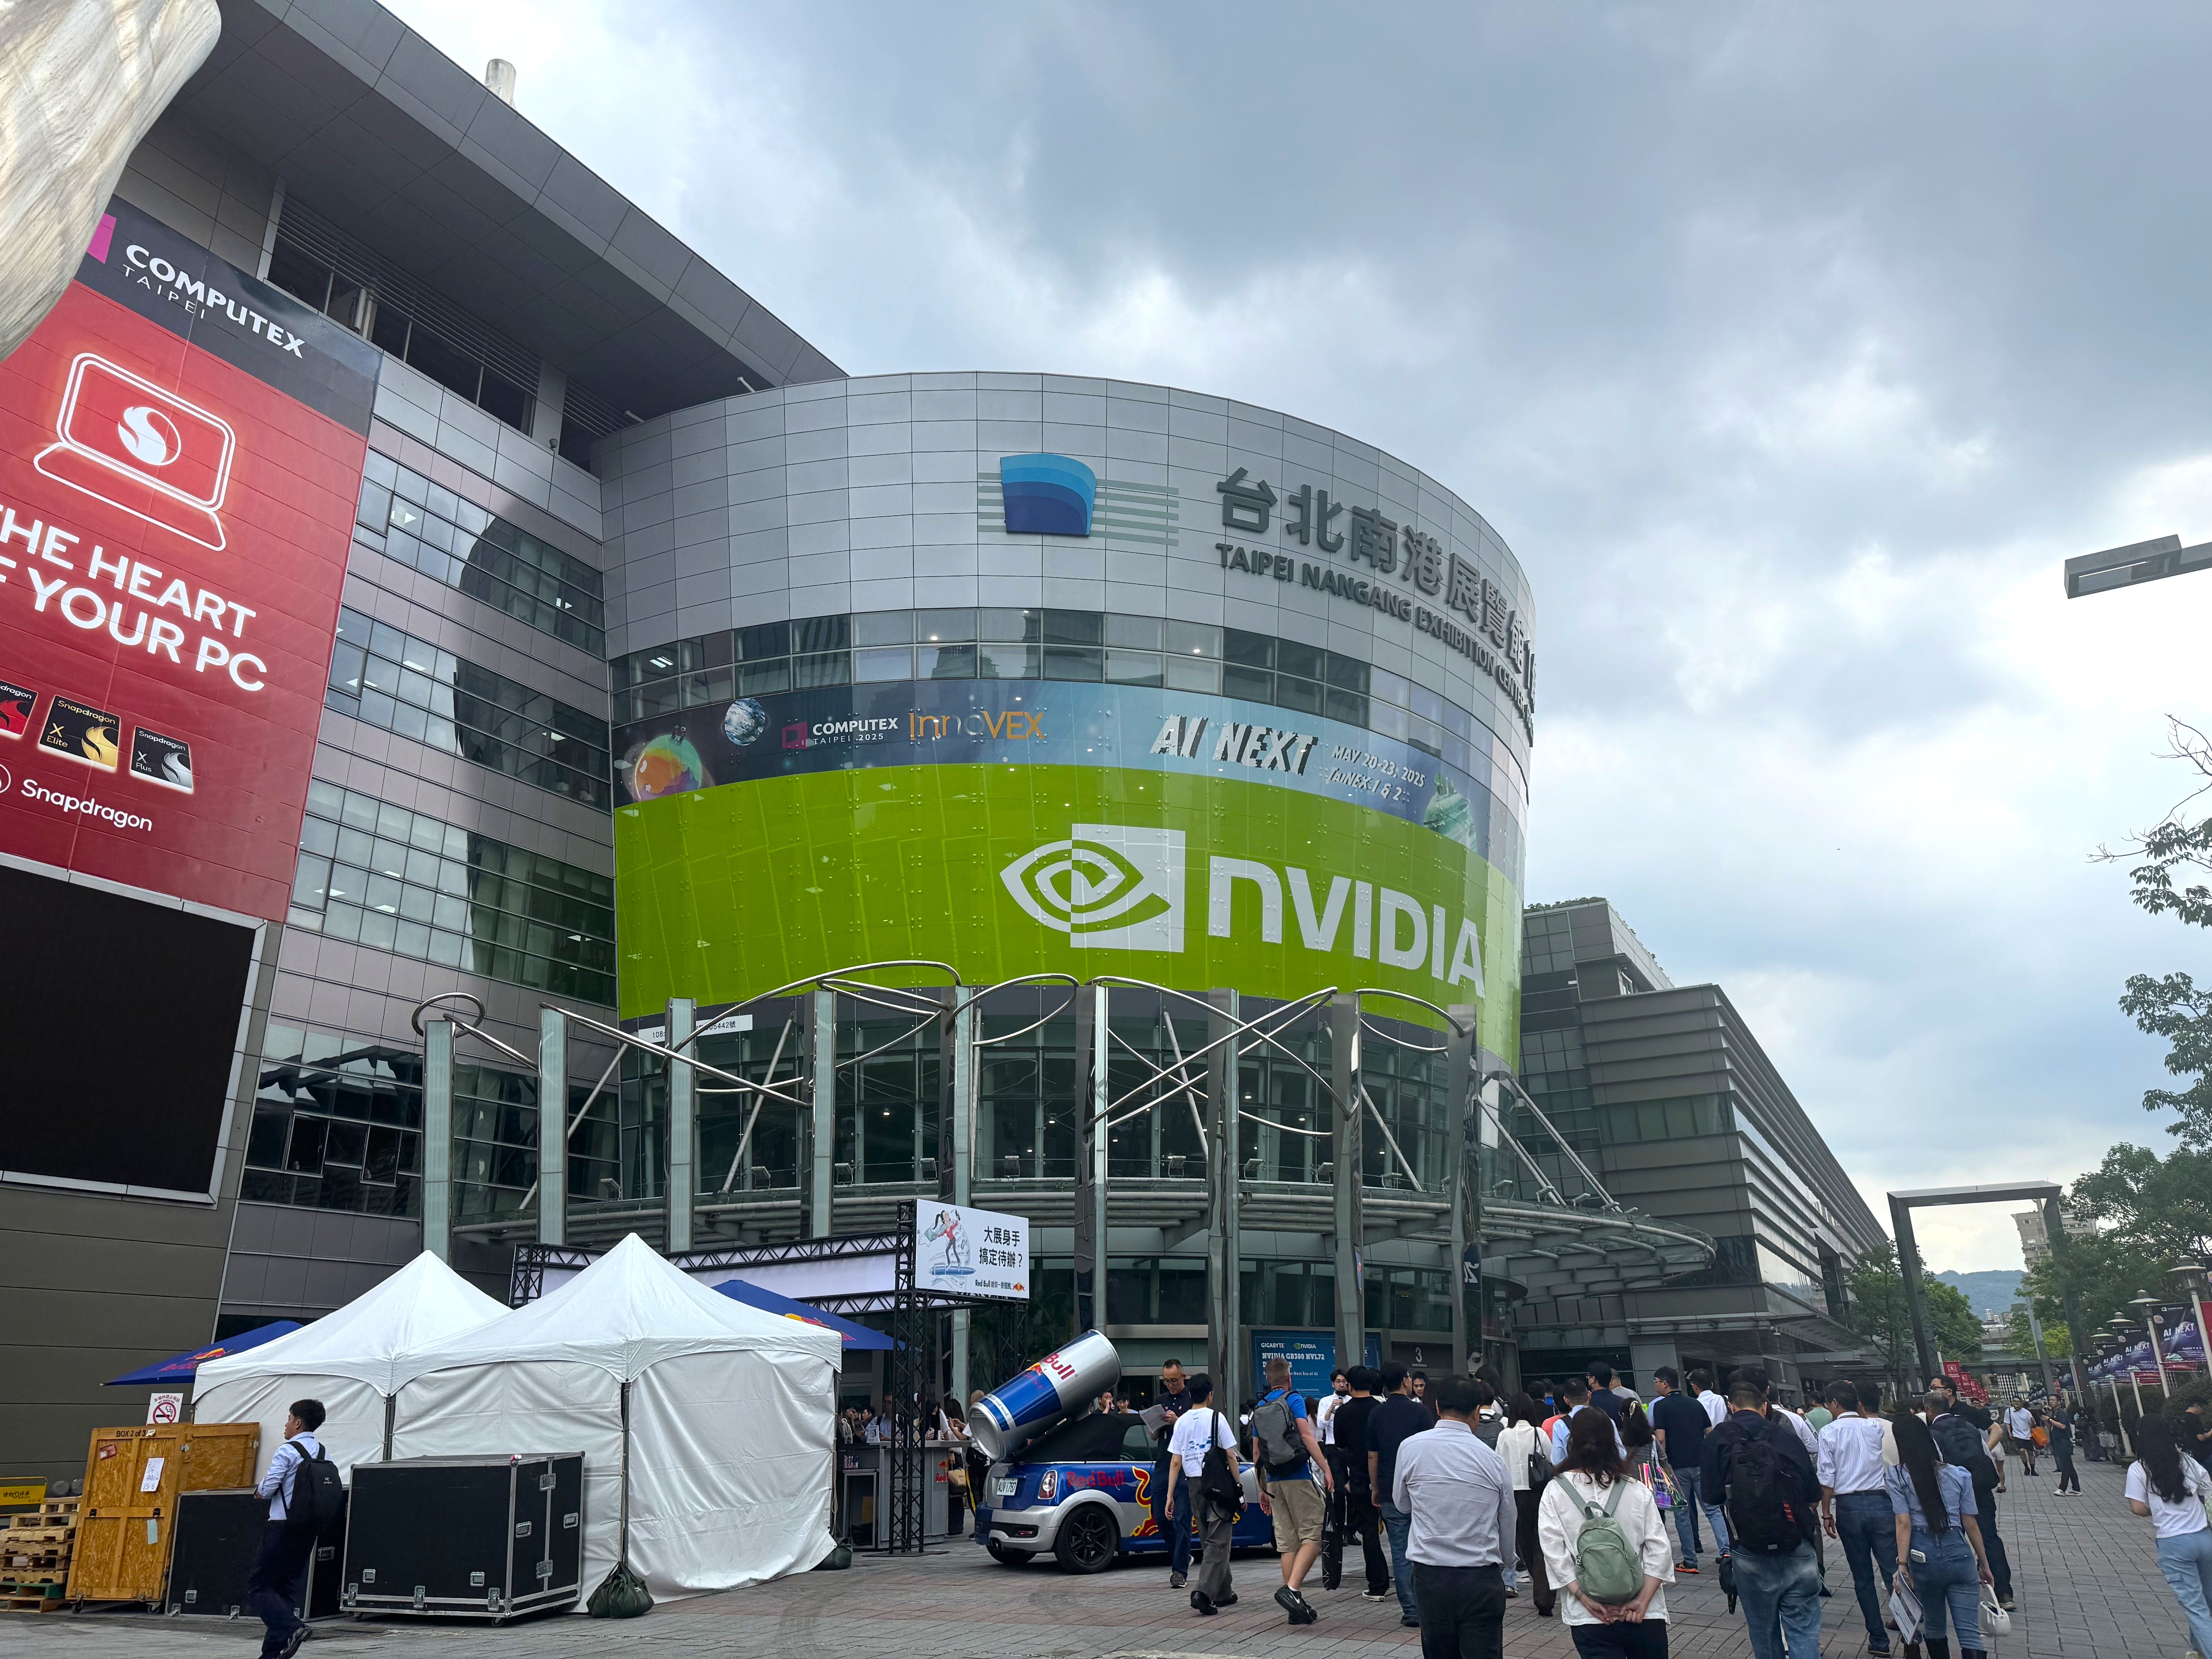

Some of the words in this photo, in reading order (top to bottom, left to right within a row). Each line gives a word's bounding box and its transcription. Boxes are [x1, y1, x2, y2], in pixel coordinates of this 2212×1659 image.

[123, 264, 205, 319] TAIPEI
[126, 244, 305, 359] COMPUTEX
[0, 505, 80, 570] HE
[88, 544, 256, 637] HEART
[1216, 543, 1294, 581] TAIPEI
[1302, 563, 1412, 621] NANGANG
[1415, 606, 1494, 676] EXHIBITION
[28, 567, 185, 665] YOUR
[196, 635, 267, 691] PC
[0, 685, 32, 699] dragon
[58, 700, 115, 725] Snapdragon
[49, 723, 65, 737] X
[813, 718, 898, 736] COMPUTEX
[46, 736, 68, 747] Elite
[139, 730, 185, 750] Snapdragon
[814, 736, 851, 745] TAIPEI
[1149, 714, 1209, 759] AI
[1212, 721, 1319, 776] NEXT
[136, 762, 152, 772] Plus
[137, 751, 147, 764] X
[1331, 745, 1362, 763] MAY
[1362, 753, 1397, 778] 20-23,
[1401, 766, 1426, 787] 2025
[1372, 780, 1381, 793] 1
[1381, 783, 1392, 799] &
[1393, 787, 1402, 801] 2
[21, 779, 152, 831] Snapdragon
[984, 1226, 1020, 1247] 大展身手
[2164, 1328, 2171, 1337] AI
[2175, 1323, 2195, 1334] NEXT
[1415, 1347, 1422, 1362] 3
[2135, 1343, 2150, 1351] NEXT
[1043, 1353, 1076, 1380] Bull
[1066, 1470, 1096, 1487] Red
[1097, 1470, 1125, 1486] Bull
